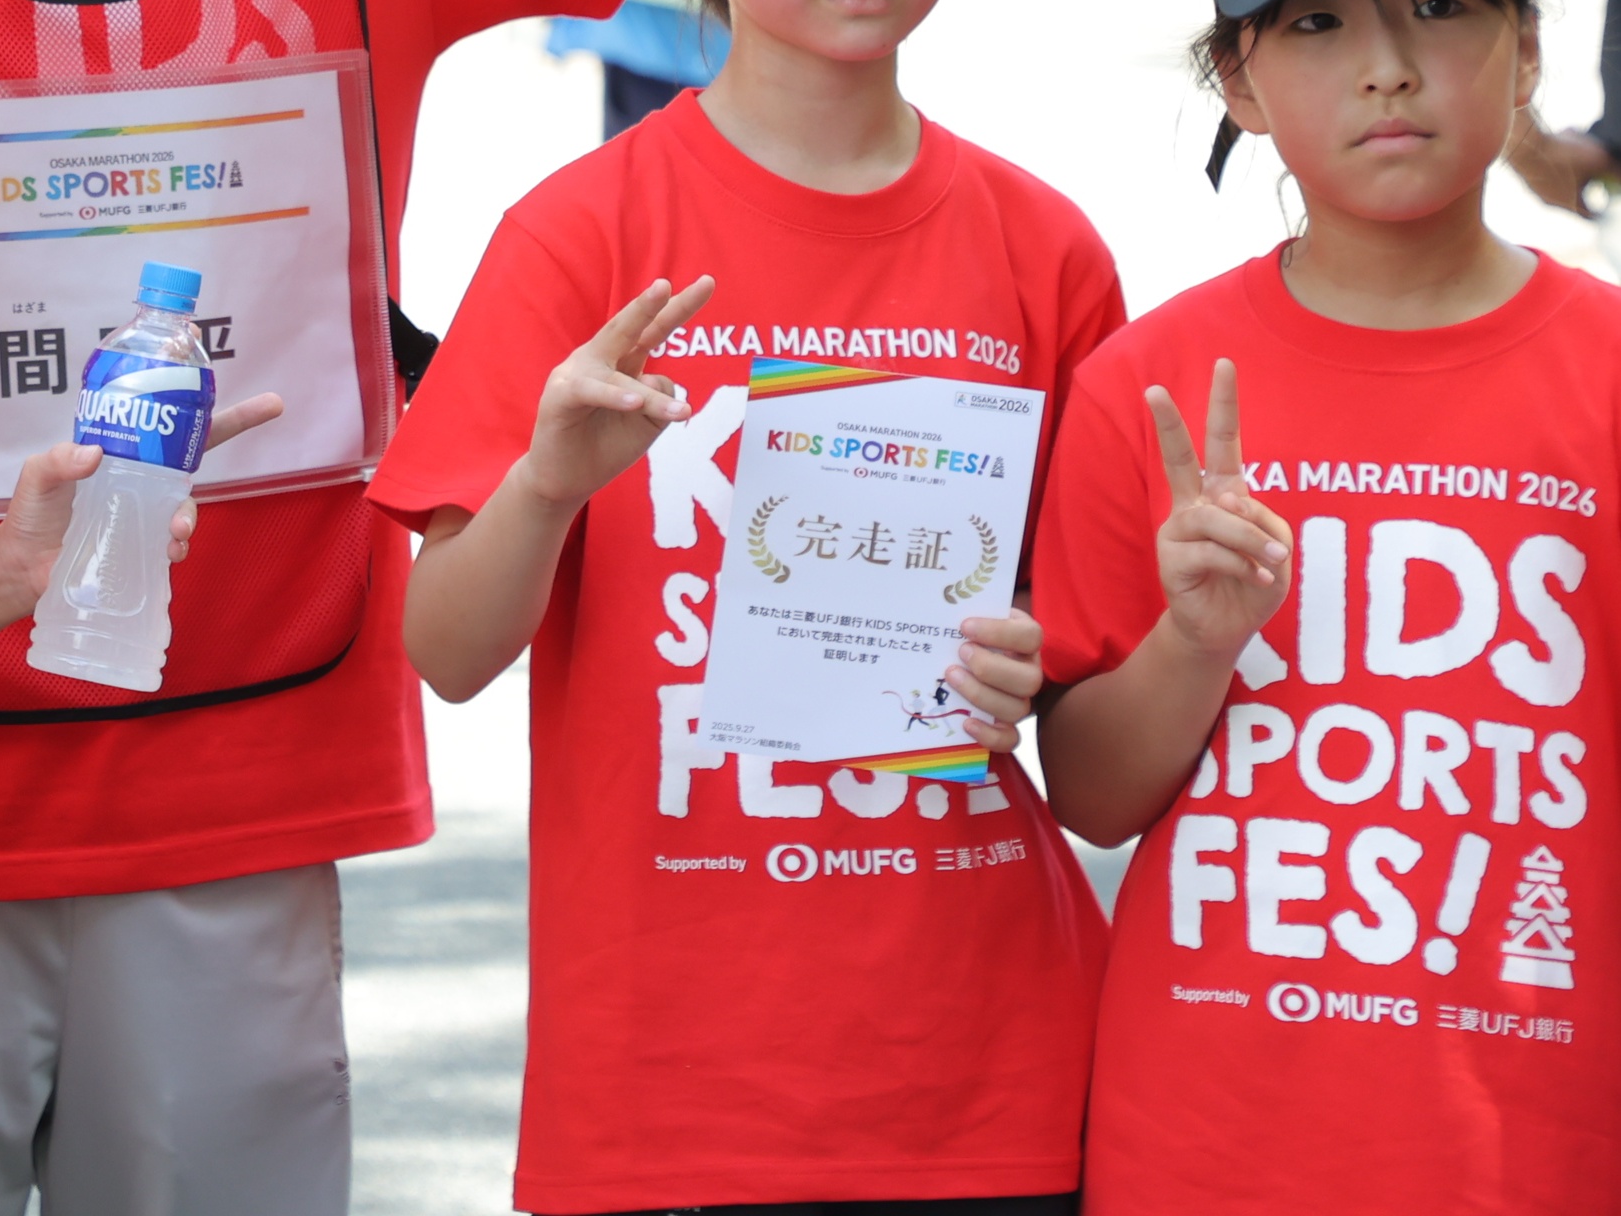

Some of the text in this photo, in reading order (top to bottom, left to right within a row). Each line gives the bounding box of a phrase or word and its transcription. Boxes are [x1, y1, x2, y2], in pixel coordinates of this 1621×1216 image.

[49, 150, 174, 169] OSAKA MARATHON 2026
[46, 168, 162, 200] SPORTS
[170, 161, 226, 192] FES!
[98, 205, 131, 217] MUFG
[12, 302, 47, 314] はざま
[772, 326, 958, 359] MARATHON
[966, 331, 1021, 376] 2026
[77, 388, 179, 436] QUARIUS
[970, 394, 998, 405] OSAKA
[998, 398, 1030, 414] 2026
[102, 428, 141, 443] HYDRATION
[837, 422, 943, 442] OSAKA MARATHON 2026
[767, 429, 991, 476] KIDS SPORTS FES!
[870, 469, 898, 481] MUFG
[1299, 460, 1508, 501] MARATHON
[1517, 472, 1598, 518] 2026
[793, 514, 953, 572] 完走証
[748, 605, 967, 640] あなたは三菱UFJ銀行 KIDS SPORTS FES
[1234, 516, 1588, 708] IDS
[777, 626, 933, 654] において完走されましたことを
[823, 648, 881, 664] 証明します
[711, 722, 756, 734] 2025.9.27
[655, 855, 728, 873] Supported
[729, 855, 747, 873] by
[823, 847, 917, 876] MUFG
[1169, 813, 1493, 977] FES!
[1171, 984, 1576, 1044] Supported by MUFG 三菱UFJ銀行
